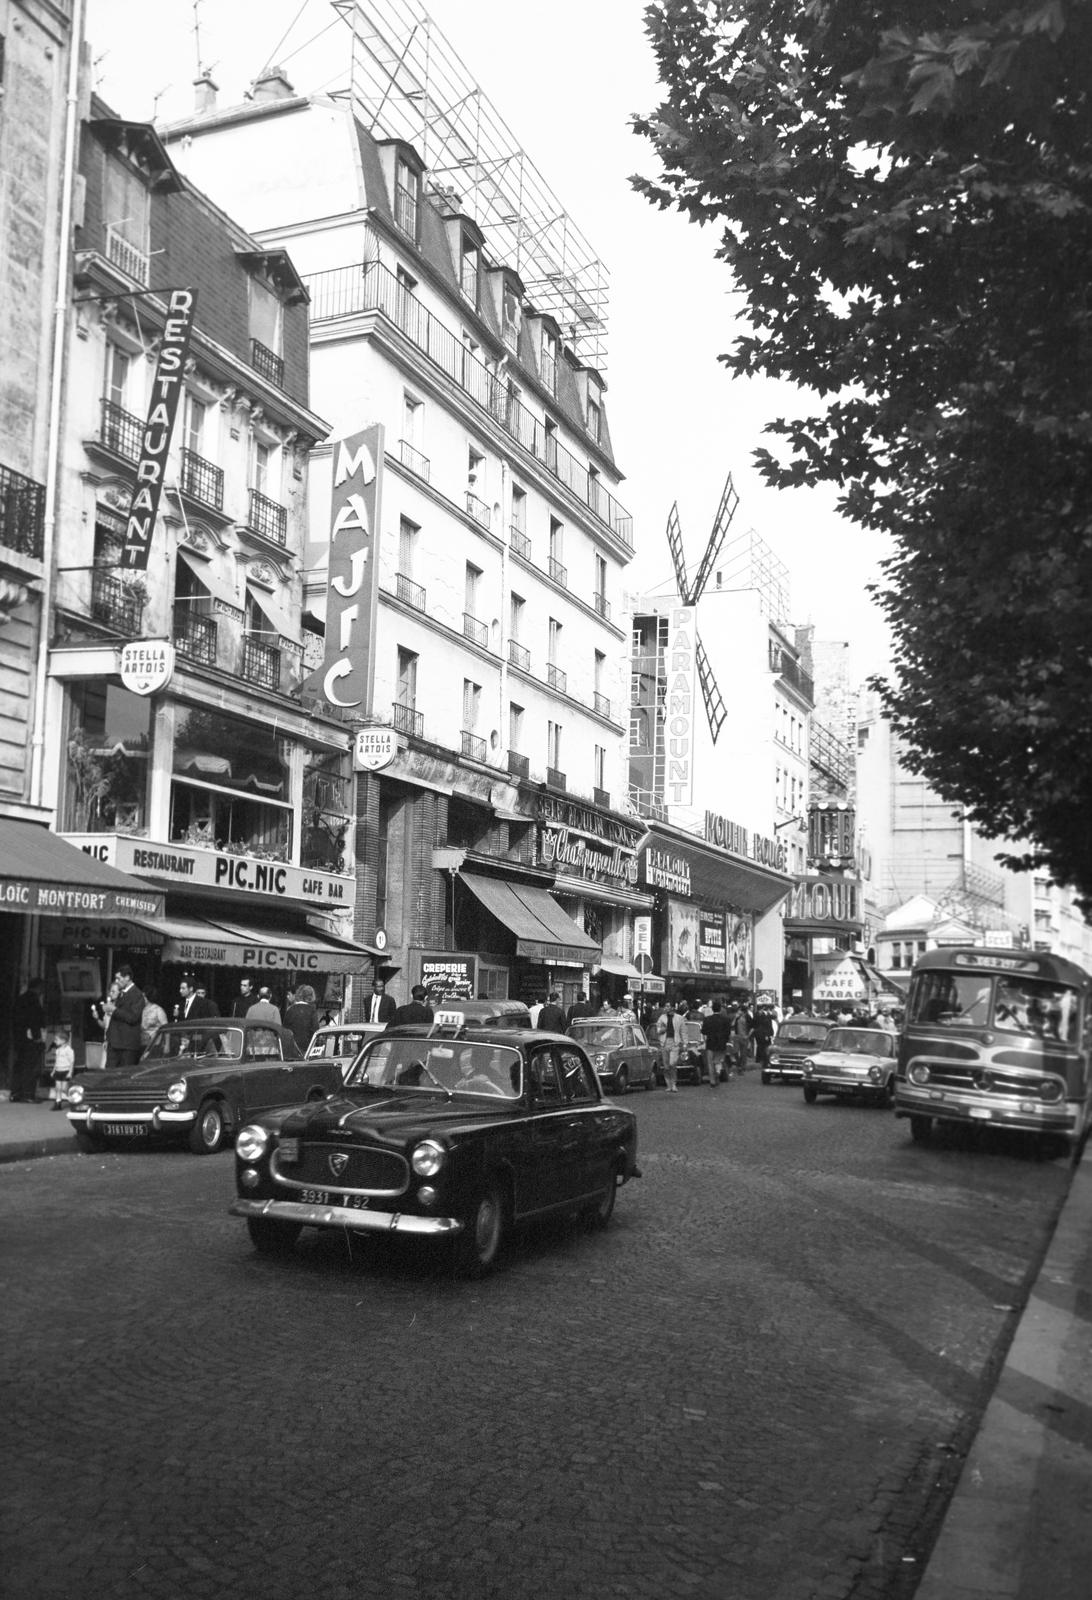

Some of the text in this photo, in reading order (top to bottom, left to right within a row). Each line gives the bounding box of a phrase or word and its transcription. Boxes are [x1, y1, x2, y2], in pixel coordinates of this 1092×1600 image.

[124, 290, 193, 565] RESTAURANT
[323, 439, 376, 707] MAJIC
[125, 650, 165, 660] STELLA
[124, 662, 165, 673] ARTOIS
[668, 608, 692, 802] PARAMOUNT
[359, 744, 391, 753] ARTOIS
[360, 735, 391, 744] STELLA
[133, 848, 196, 876] RESTAURANT
[37, 887, 107, 910] MONTFORT
[302, 878, 344, 899] CAFE BAR
[243, 949, 319, 969] PIC-NIC
[819, 990, 863, 998] TABAC
[439, 1014, 462, 1024] TAXI
[301, 1189, 329, 1204] 3931
[353, 1196, 370, 1209] 92
